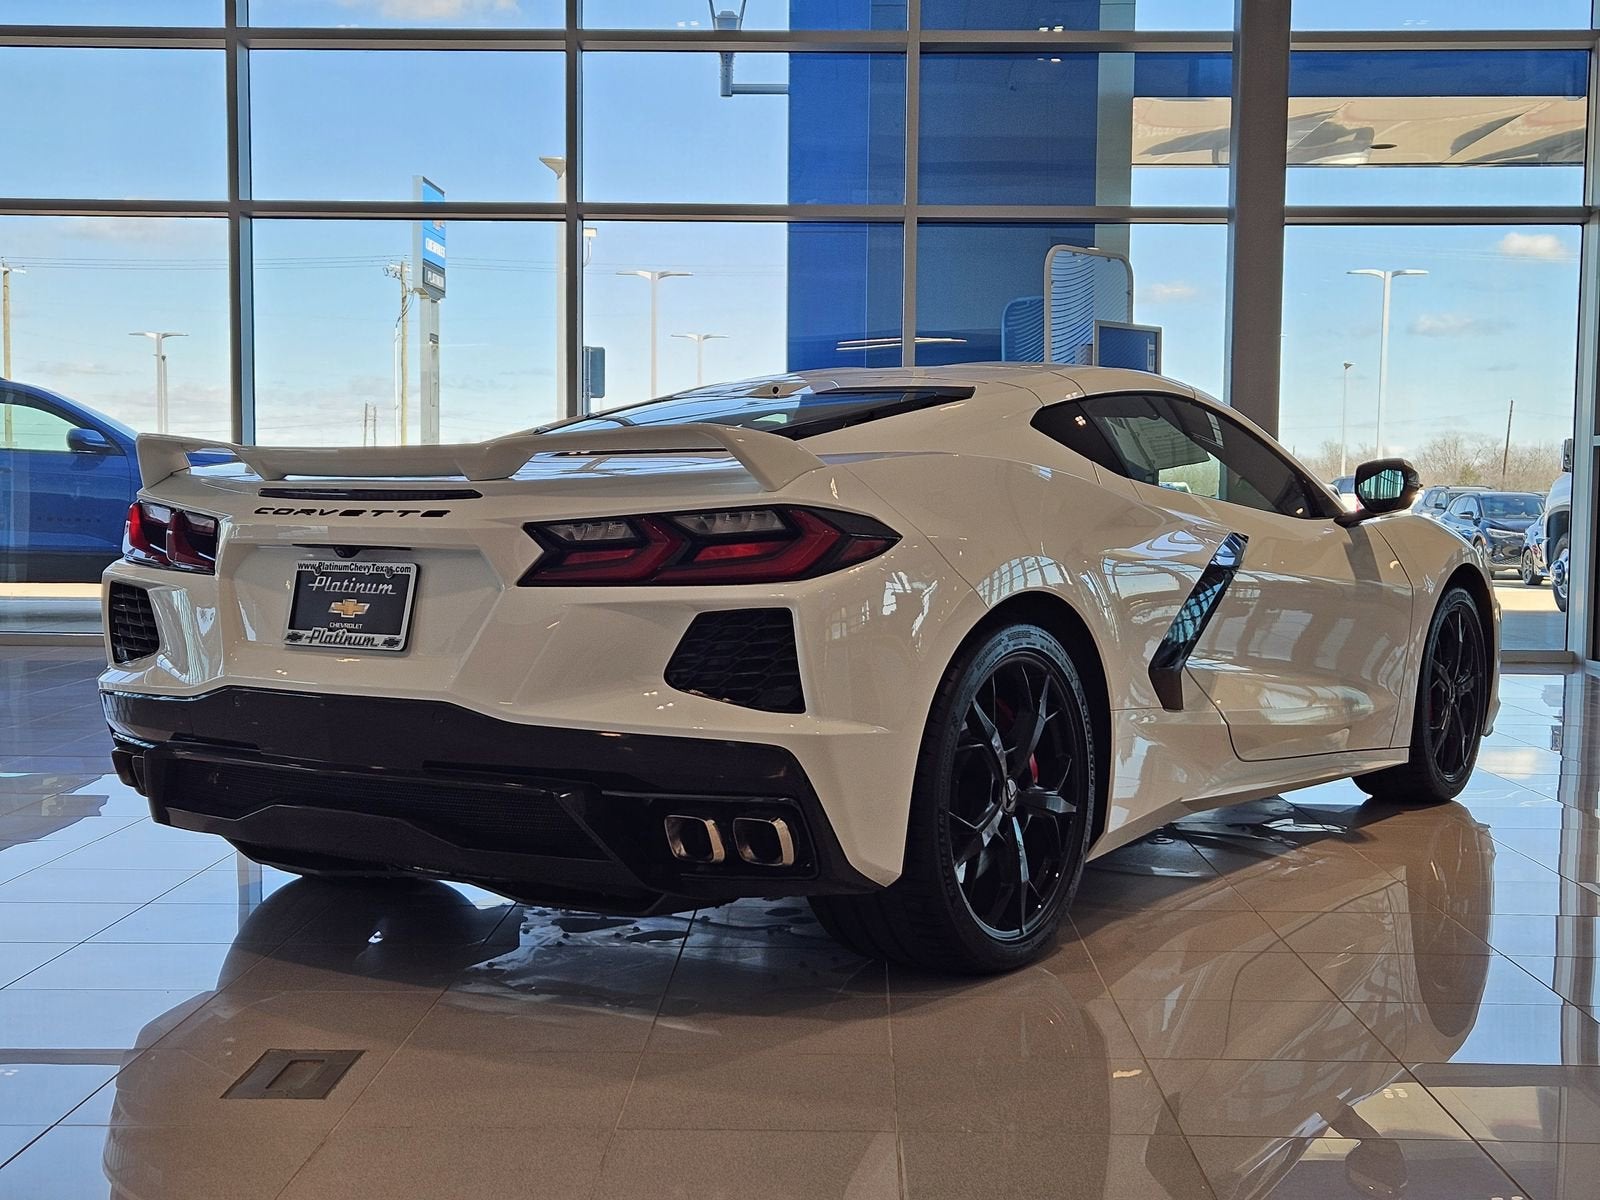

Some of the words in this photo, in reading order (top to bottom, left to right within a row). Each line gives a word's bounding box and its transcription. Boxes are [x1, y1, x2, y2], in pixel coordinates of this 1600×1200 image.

[254, 508, 451, 517] CORVETTE
[298, 562, 411, 575] wwwPlatinumChevyTexas.com
[308, 576, 397, 595] Platinum
[329, 622, 363, 630] CHEVROLET
[304, 629, 380, 647] Platinum
